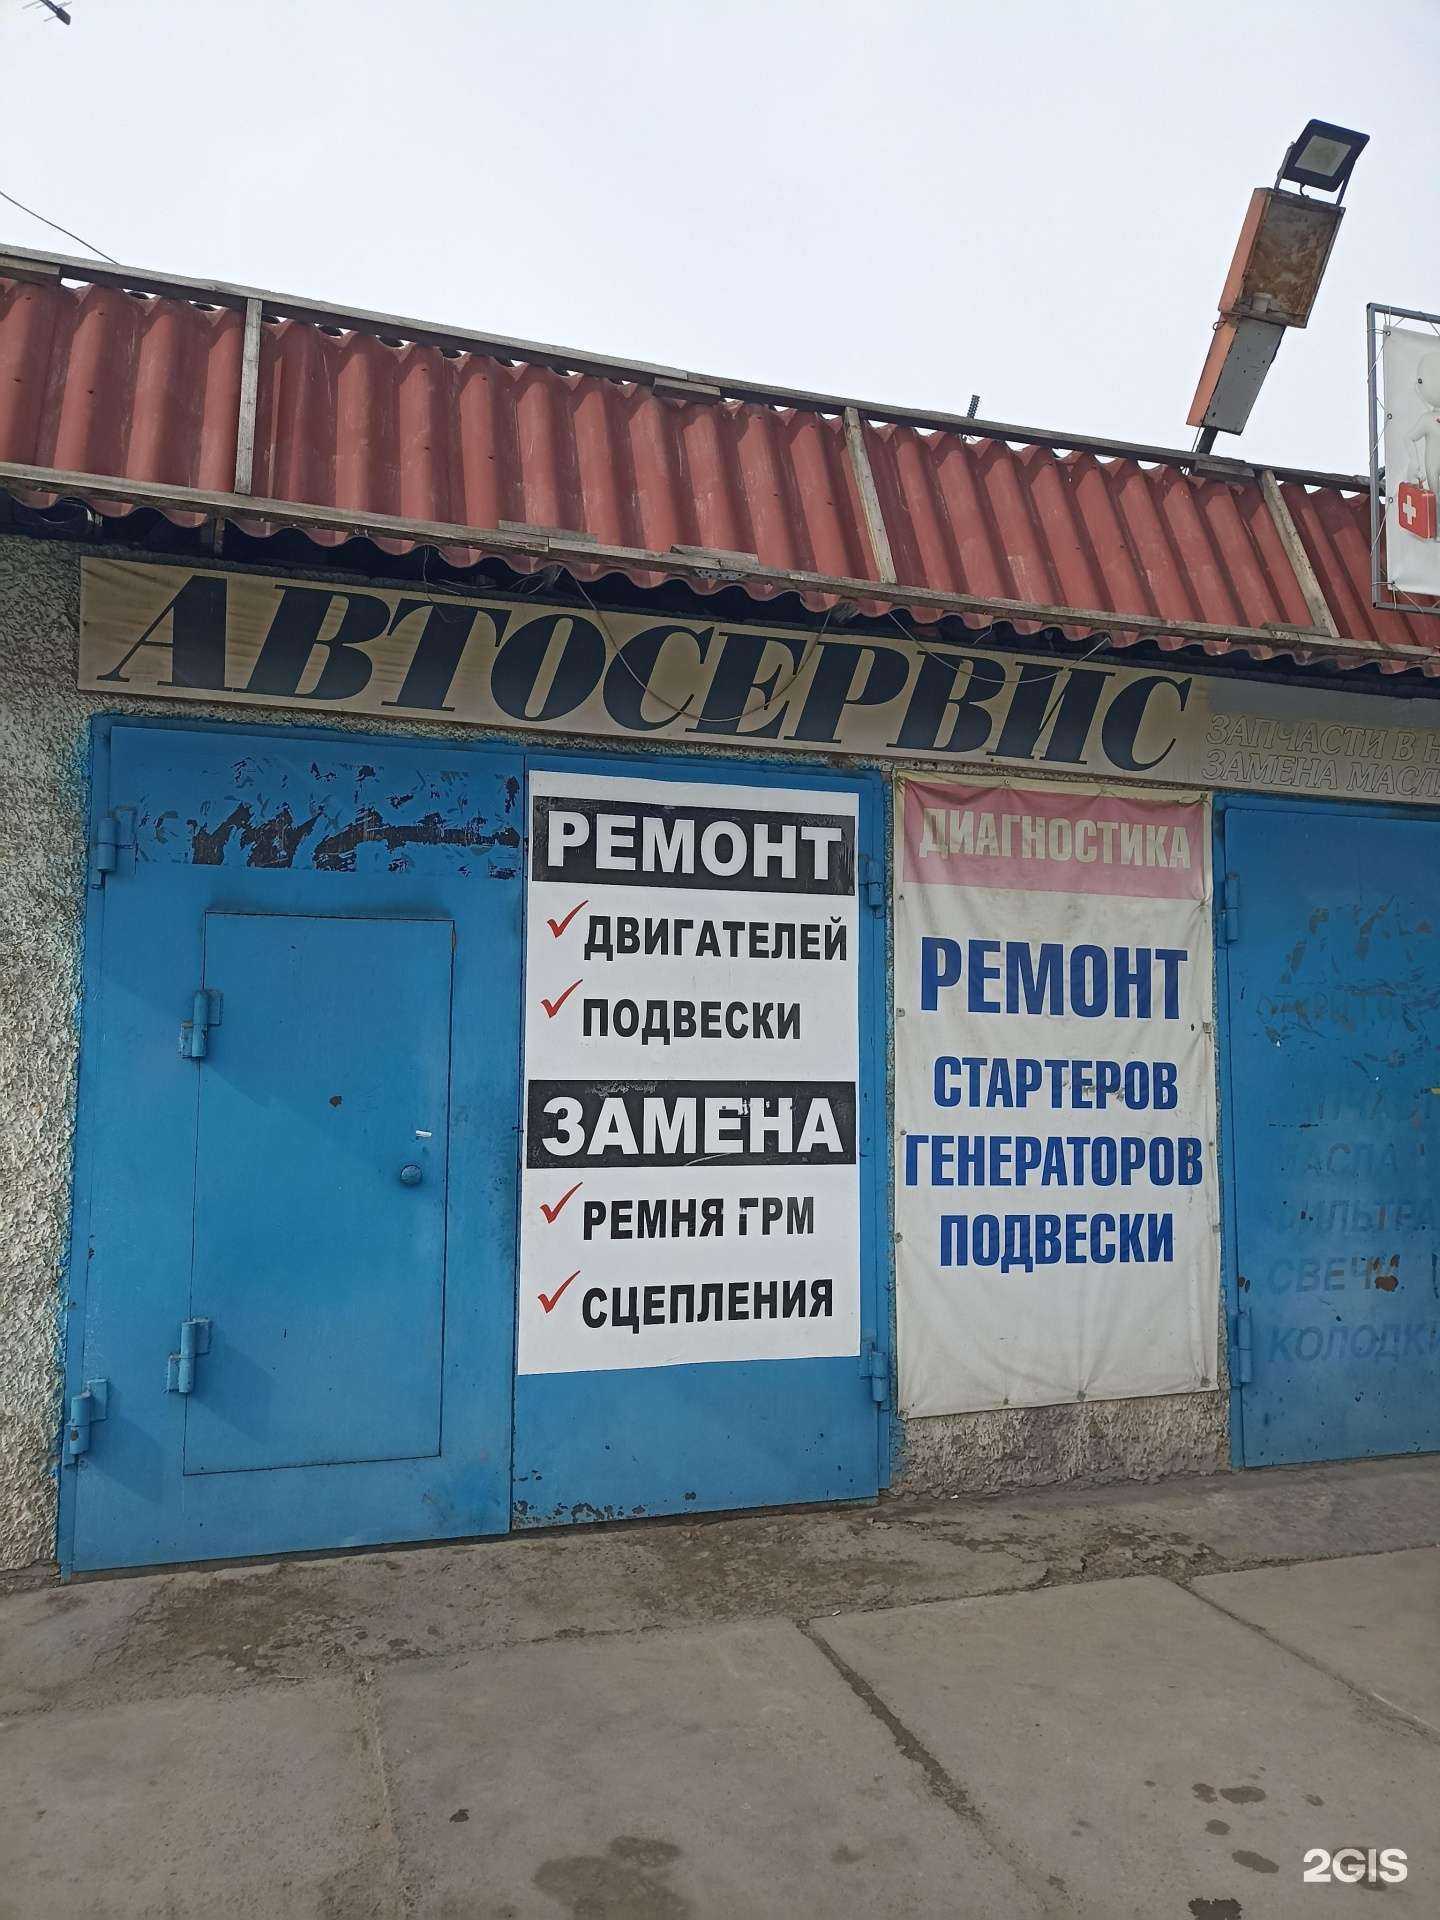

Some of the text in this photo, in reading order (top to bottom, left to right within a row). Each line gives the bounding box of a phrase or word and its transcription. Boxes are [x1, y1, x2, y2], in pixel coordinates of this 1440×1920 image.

[97, 574, 1193, 772] АВТОСЕРВИС
[1205, 713, 1388, 759] ЗАПЧАСТИ
[1201, 749, 1337, 789] ЗАМЕНА
[548, 810, 842, 880] РЕМОНТ
[919, 808, 1191, 869] ДИАГНОСТИКА
[584, 915, 847, 961] ДВИГАТЕЛЕЙ
[921, 936, 1188, 1020] РЕМОНТ
[583, 998, 801, 1046] ПОДВЕСКИ
[933, 1056, 1178, 1110] СТАРТЕРОВ
[541, 1096, 844, 1156] ЗАМЕНА
[905, 1135, 1203, 1186] ГЕНЕРАТОРОВ
[583, 1196, 814, 1240] РЕМНЯ ГРМ
[940, 1213, 1173, 1273] ПОДВЕСКИ
[582, 1279, 833, 1334] СЦЕПЛЕНИЯ
